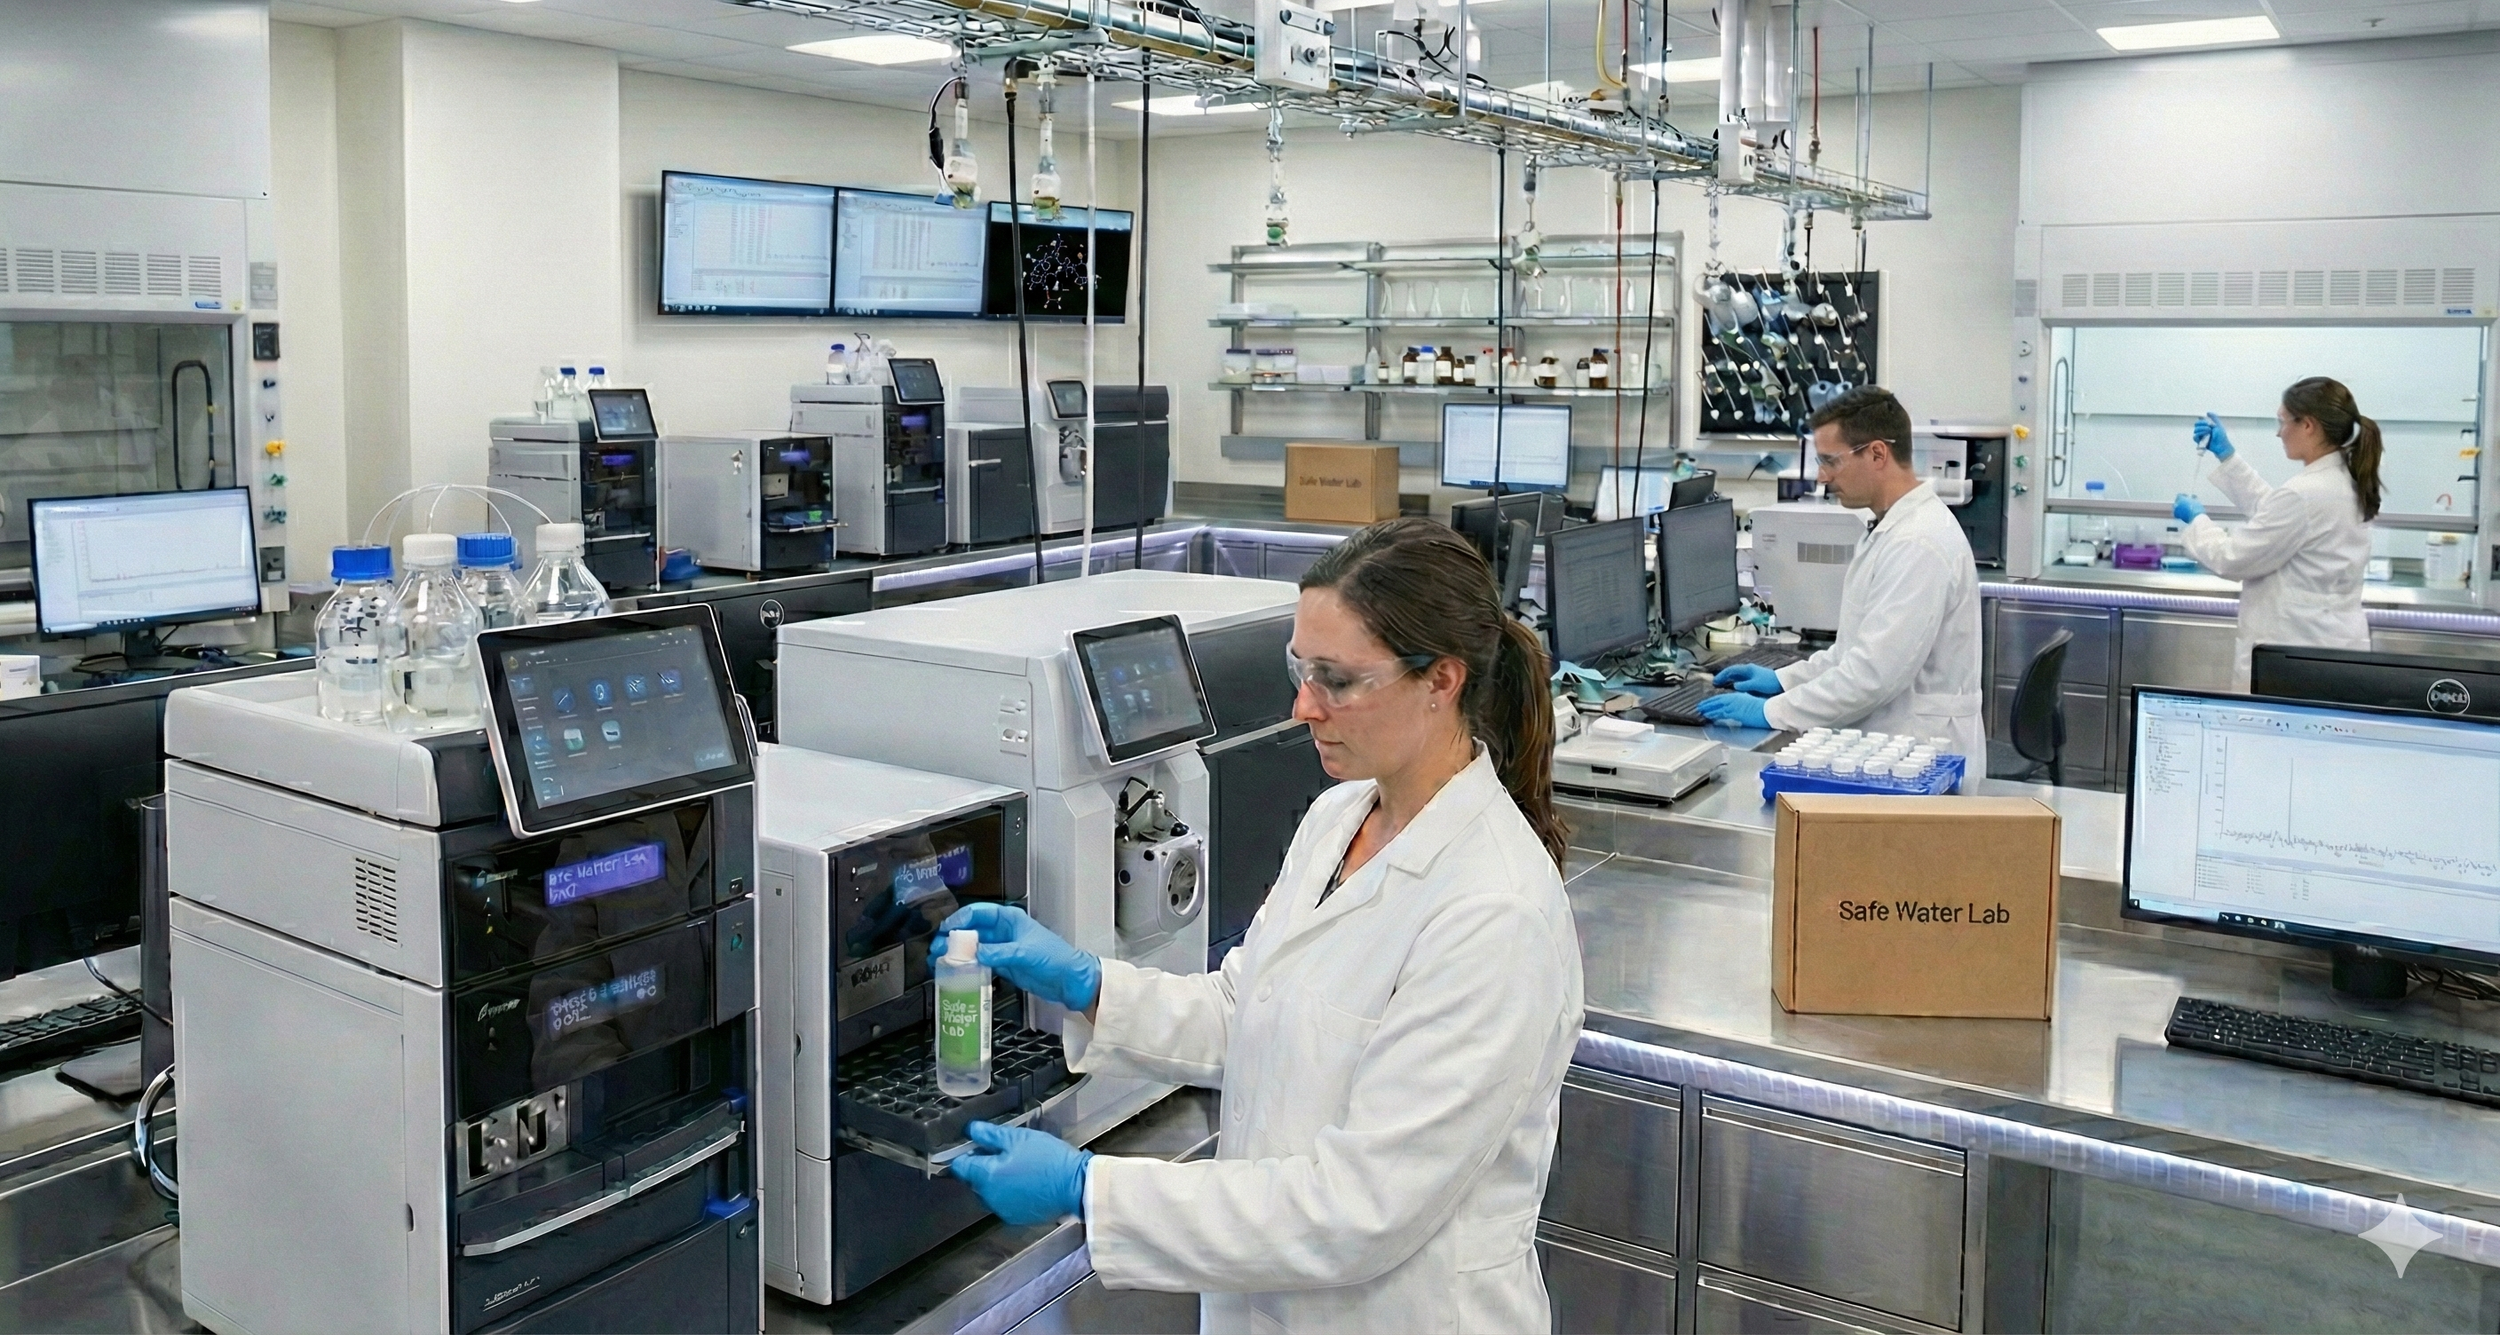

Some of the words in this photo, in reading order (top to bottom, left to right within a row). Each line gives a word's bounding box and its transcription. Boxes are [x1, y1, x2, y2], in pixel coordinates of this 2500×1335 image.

[1839, 900, 1889, 922] Safe
[1895, 901, 1963, 923] Water
[1968, 902, 2010, 924] Lab
